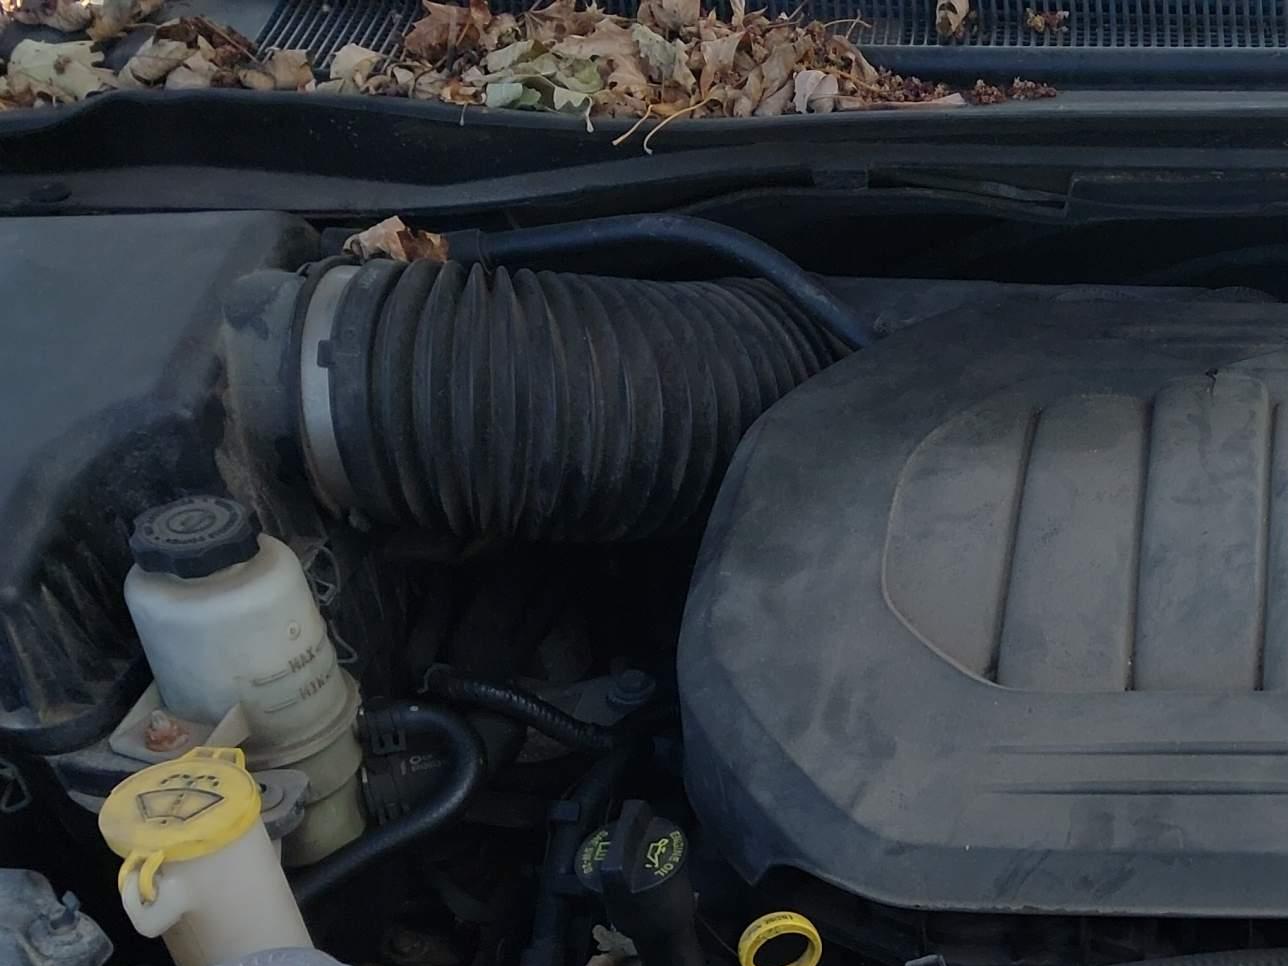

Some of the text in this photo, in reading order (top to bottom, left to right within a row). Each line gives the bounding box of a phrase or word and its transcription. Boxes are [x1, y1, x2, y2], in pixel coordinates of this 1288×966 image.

[288, 647, 315, 673] MAX
[299, 674, 325, 700] MIN
[654, 830, 684, 877] ENGINE OIL
